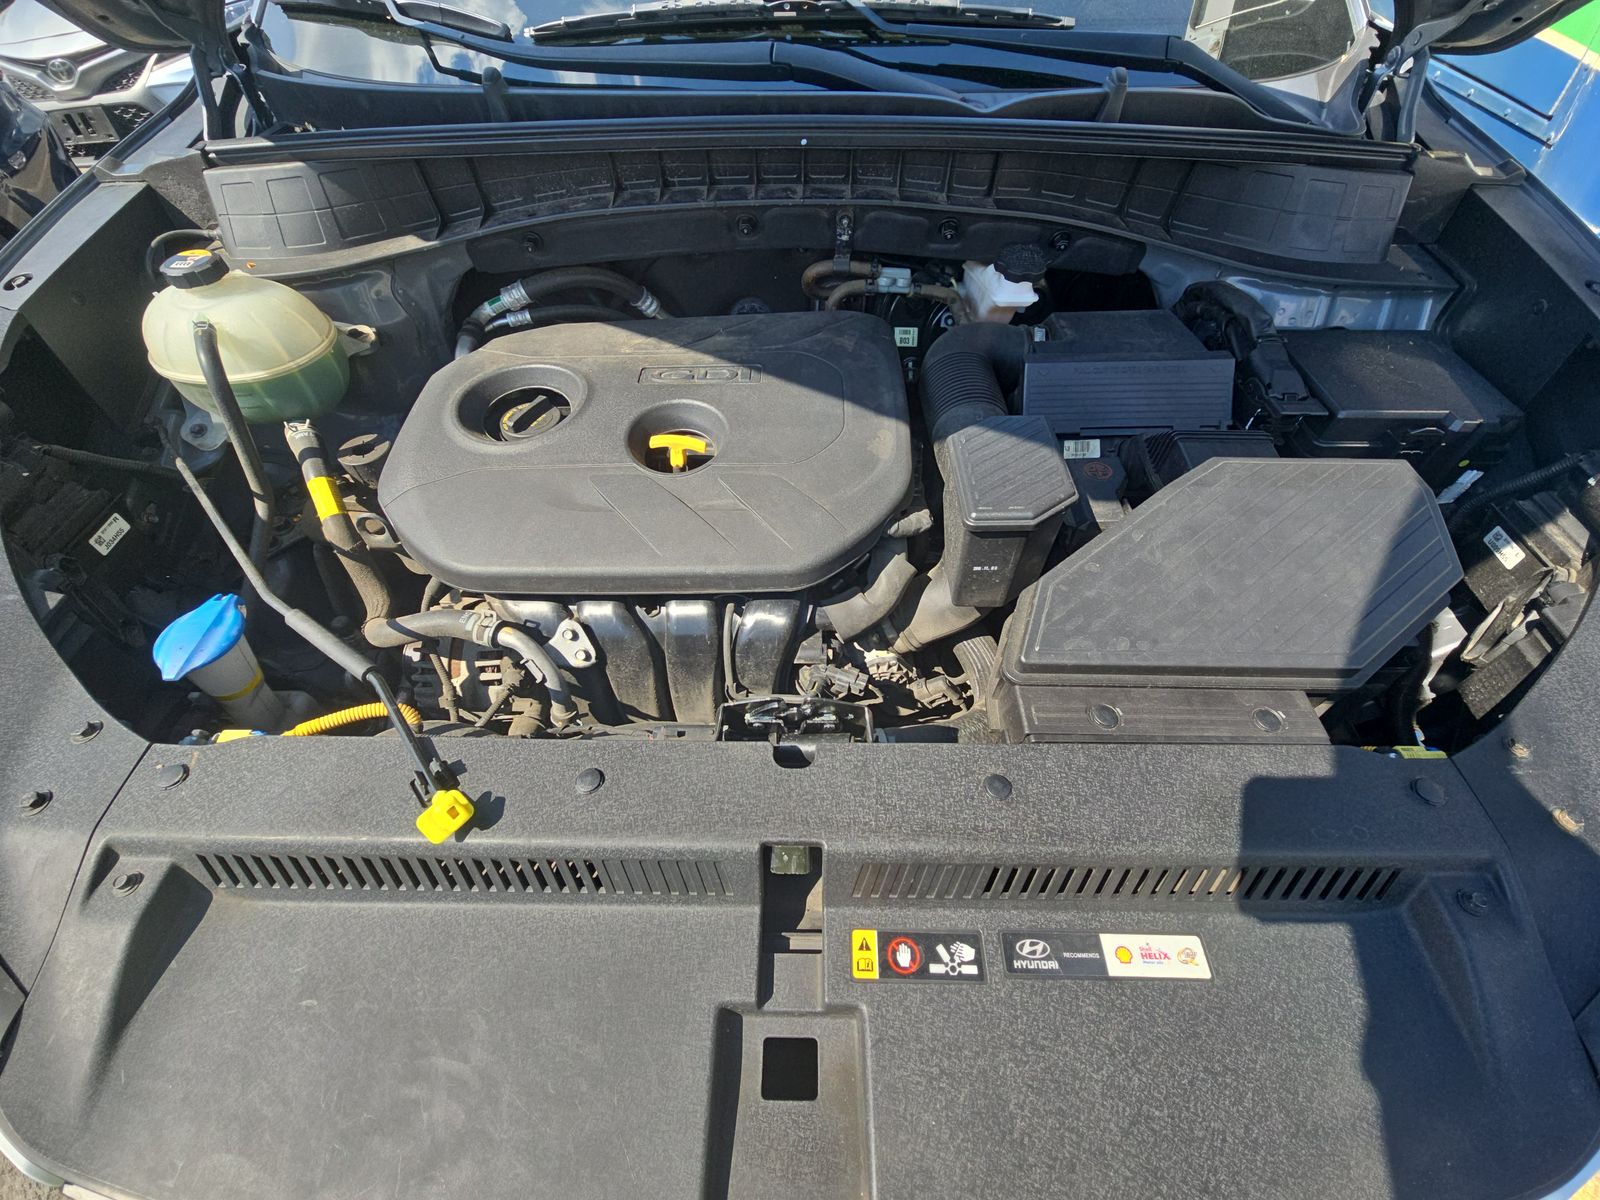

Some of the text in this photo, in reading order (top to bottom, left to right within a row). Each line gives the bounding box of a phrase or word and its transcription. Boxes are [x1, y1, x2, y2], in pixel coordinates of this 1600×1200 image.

[652, 367, 751, 382] GDI
[112, 516, 120, 524] R
[1140, 952, 1172, 961] HELIX
[1013, 960, 1059, 970] HYUNDAI
